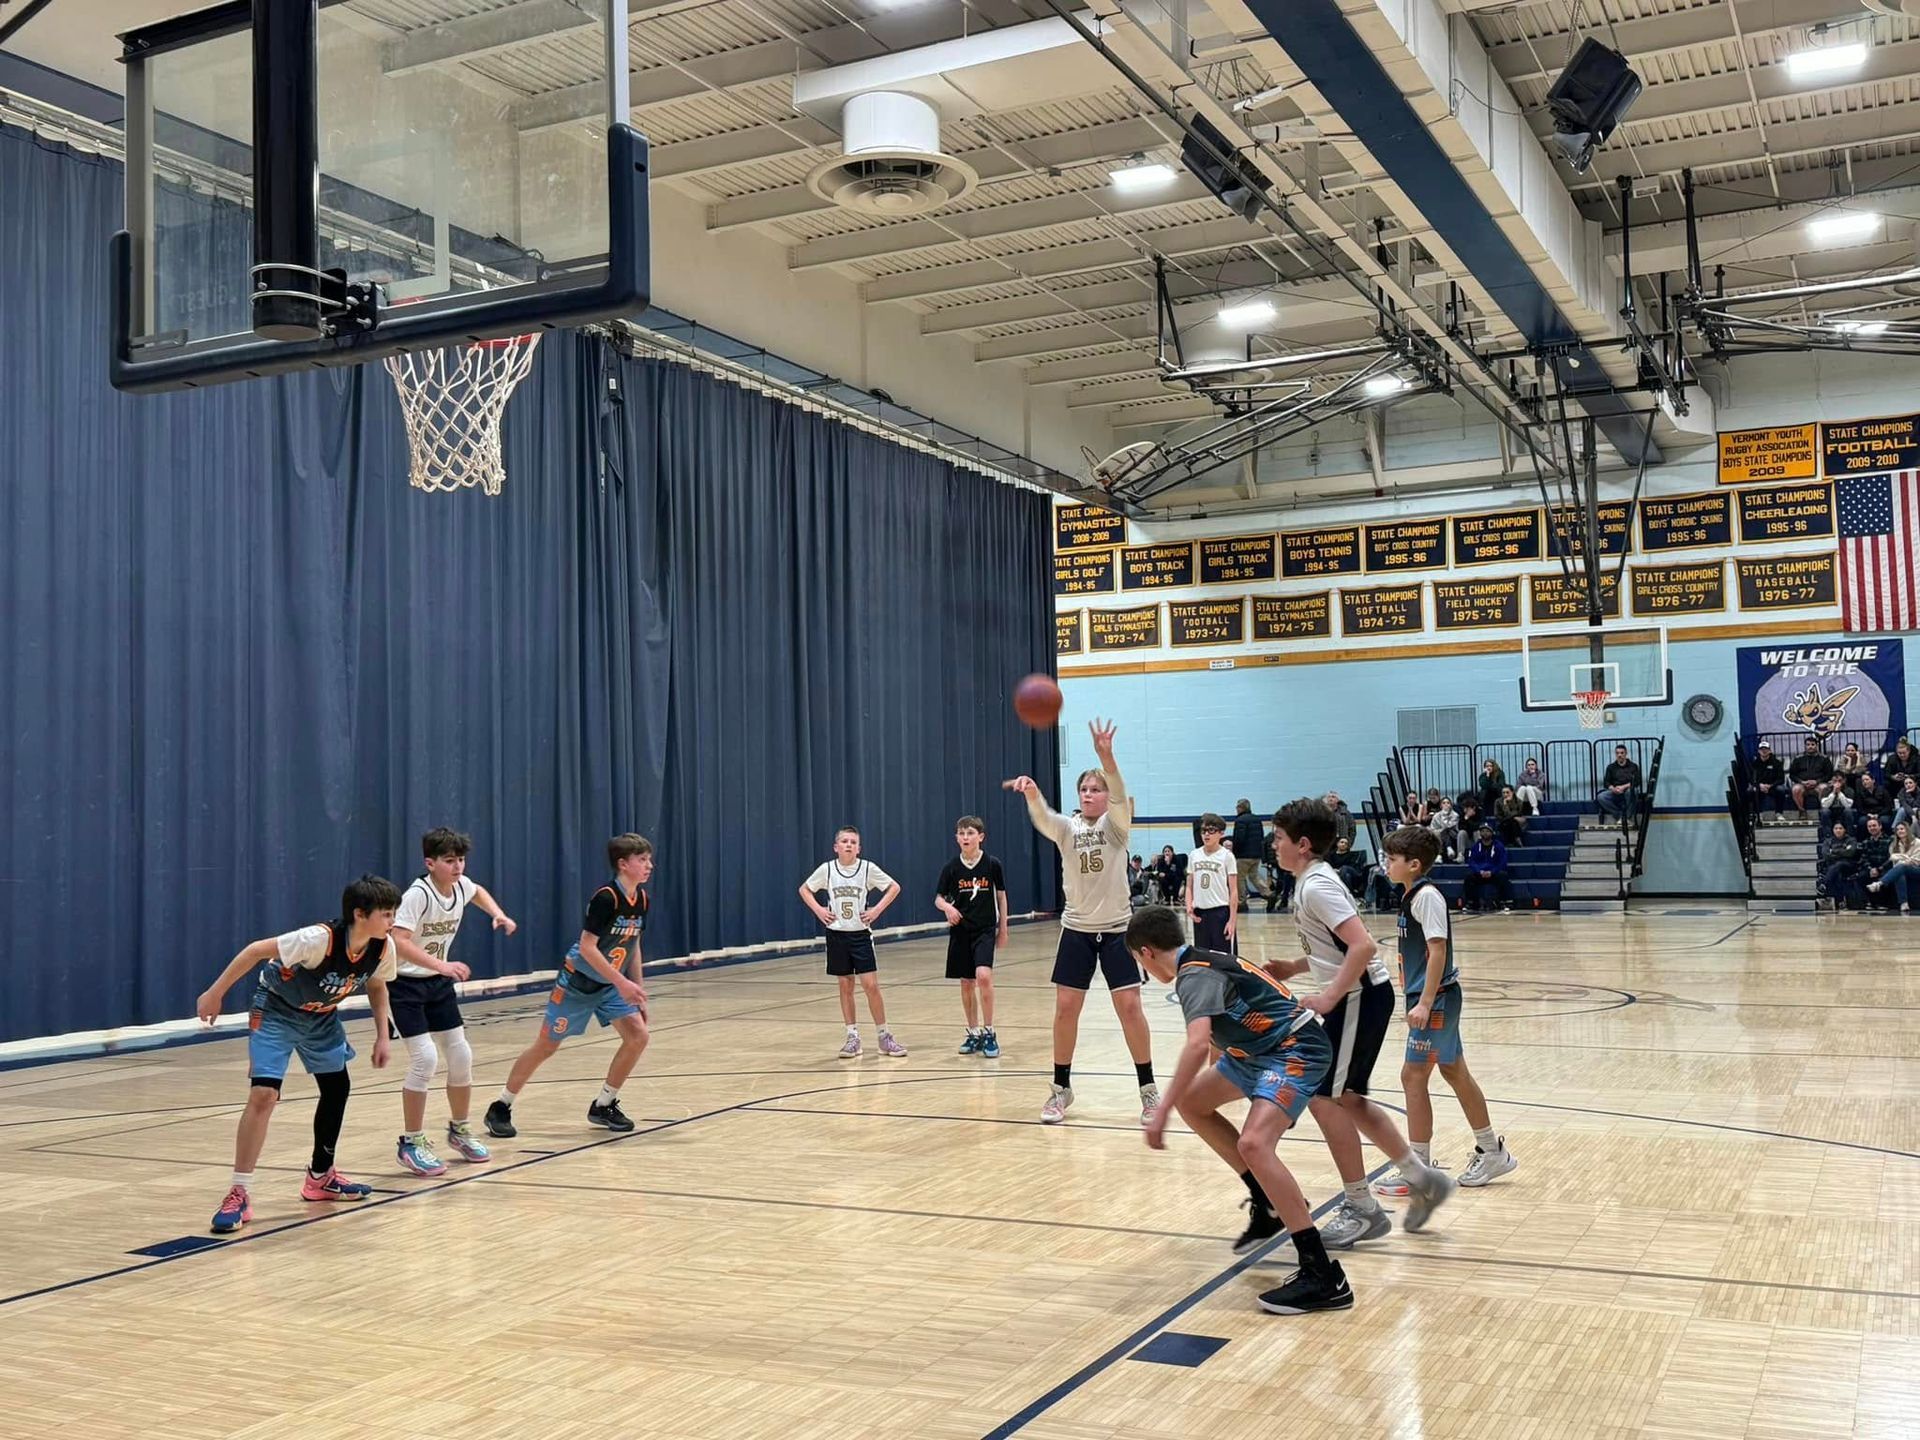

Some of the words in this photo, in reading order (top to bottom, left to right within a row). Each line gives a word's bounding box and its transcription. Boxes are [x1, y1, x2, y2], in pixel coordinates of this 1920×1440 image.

[1732, 432, 1770, 443] VERMONT
[1775, 429, 1803, 439] YOUTH
[1829, 427, 1858, 439] STATE
[1862, 421, 1913, 436] CHAMPIONS
[1725, 445, 1753, 455] RUGBY
[1756, 440, 1809, 453] ASSOCIATION
[1826, 436, 1918, 455] FOOTBALL
[1723, 456, 1742, 468] BOYS
[1744, 454, 1768, 465] STATE
[1771, 451, 1812, 463] CHAMPIONS
[1846, 453, 1900, 468] 2009-2010
[1749, 466, 1785, 476] 2009
[1745, 493, 1773, 506] STATE
[1776, 489, 1825, 503] CHAMPIONS
[1061, 508, 1081, 519] STATE
[1646, 504, 1674, 516] STATE
[1678, 499, 1724, 514] CHAMPIONS
[1745, 504, 1828, 520] CHEERLEADING
[1060, 517, 1121, 532] GYMNASTICS
[1460, 521, 1484, 532] STATE
[1488, 516, 1532, 529] CHAMPIONS
[1671, 516, 1697, 527] NORDIC
[1701, 514, 1723, 524] SKIING
[1766, 520, 1807, 534] 1995-96
[1371, 529, 1395, 540] STATE
[1398, 525, 1440, 537] CHAMPIONS
[1603, 523, 1625, 533] SKIING
[1286, 536, 1311, 547] STATE
[1313, 532, 1355, 545] CHAMPIONS
[1482, 533, 1501, 543] CROSS
[1503, 530, 1529, 541] COUNTRY
[1667, 531, 1706, 543] 1995-96
[1205, 544, 1228, 554] STATE
[1230, 540, 1271, 551] CHAMPIONS
[1392, 541, 1409, 551] CROSS
[1411, 539, 1437, 549] COUNTRY
[1474, 544, 1519, 557] 1995-96
[1125, 550, 1148, 561] STATE
[1151, 547, 1189, 558] CHAMPIONS
[1290, 549, 1316, 560] BOYS
[1318, 545, 1352, 558] TENNIS
[1384, 552, 1427, 565] 1995-96
[1055, 557, 1071, 567] TATE
[1073, 554, 1111, 565] CHAMPIONS
[1130, 563, 1153, 573] BOYS
[1156, 560, 1184, 571] TRACK
[1208, 556, 1234, 567] GIRLS
[1238, 553, 1267, 564] TRACK
[1304, 560, 1339, 572] 1994-95
[1055, 569, 1079, 580] GIRLS
[1083, 567, 1105, 577] GOLF
[1221, 567, 1255, 578] 1994-95
[1742, 565, 1773, 577] STATE
[1776, 559, 1830, 574] CHAMPIONS
[1142, 574, 1173, 585] 1994-95
[1636, 571, 1666, 583] STATE
[1670, 567, 1719, 581] CHAMPIONS
[1756, 575, 1818, 588] BASEBALL
[1065, 580, 1096, 591] 1994-95
[1438, 587, 1466, 598] STATE
[1469, 583, 1515, 595] CHAMPIONS
[1535, 580, 1563, 591] STATE
[1637, 584, 1658, 595] GIRLS
[1659, 584, 1683, 594] CROSS
[1685, 582, 1719, 593] COUNTRY
[1345, 594, 1371, 605] STATE
[1375, 590, 1418, 602] CHAMPIONS
[1536, 592, 1559, 602] GIRLS
[1651, 594, 1705, 607] 1976-77
[1759, 587, 1815, 602] 1976-77
[1256, 602, 1281, 612] STATE
[1285, 598, 1326, 610] CHAMPIONS
[1446, 599, 1471, 609] FIELD
[1474, 596, 1508, 607] HOCKEY
[1173, 607, 1196, 617] STATE
[1199, 604, 1240, 615] CHAMPIONS
[1258, 613, 1279, 622] GIRLS
[1280, 609, 1326, 621] GYMNASTICS
[1356, 603, 1407, 616] SOFTBALL
[1453, 609, 1502, 622] 1975-76
[1092, 614, 1115, 624] STATE
[1118, 610, 1155, 622] CHAMPIONS
[1183, 617, 1230, 626] FOOTBALL
[1359, 615, 1406, 629] 1974-75
[1057, 628, 1071, 636] ACK
[1093, 624, 1112, 633] GIRLS
[1114, 621, 1155, 632] GYMNASTICS
[1185, 627, 1228, 639] 1973-74
[1269, 622, 1315, 633] 1974-75
[1103, 632, 1145, 644] 1973-74
[1760, 645, 1878, 665] WELCOME
[1780, 665, 1807, 679] TO
[1817, 662, 1859, 677] THE
[1079, 849, 1104, 873] 15
[1200, 873, 1210, 889] 0
[841, 901, 853, 919] 5
[553, 1016, 569, 1034] 3
